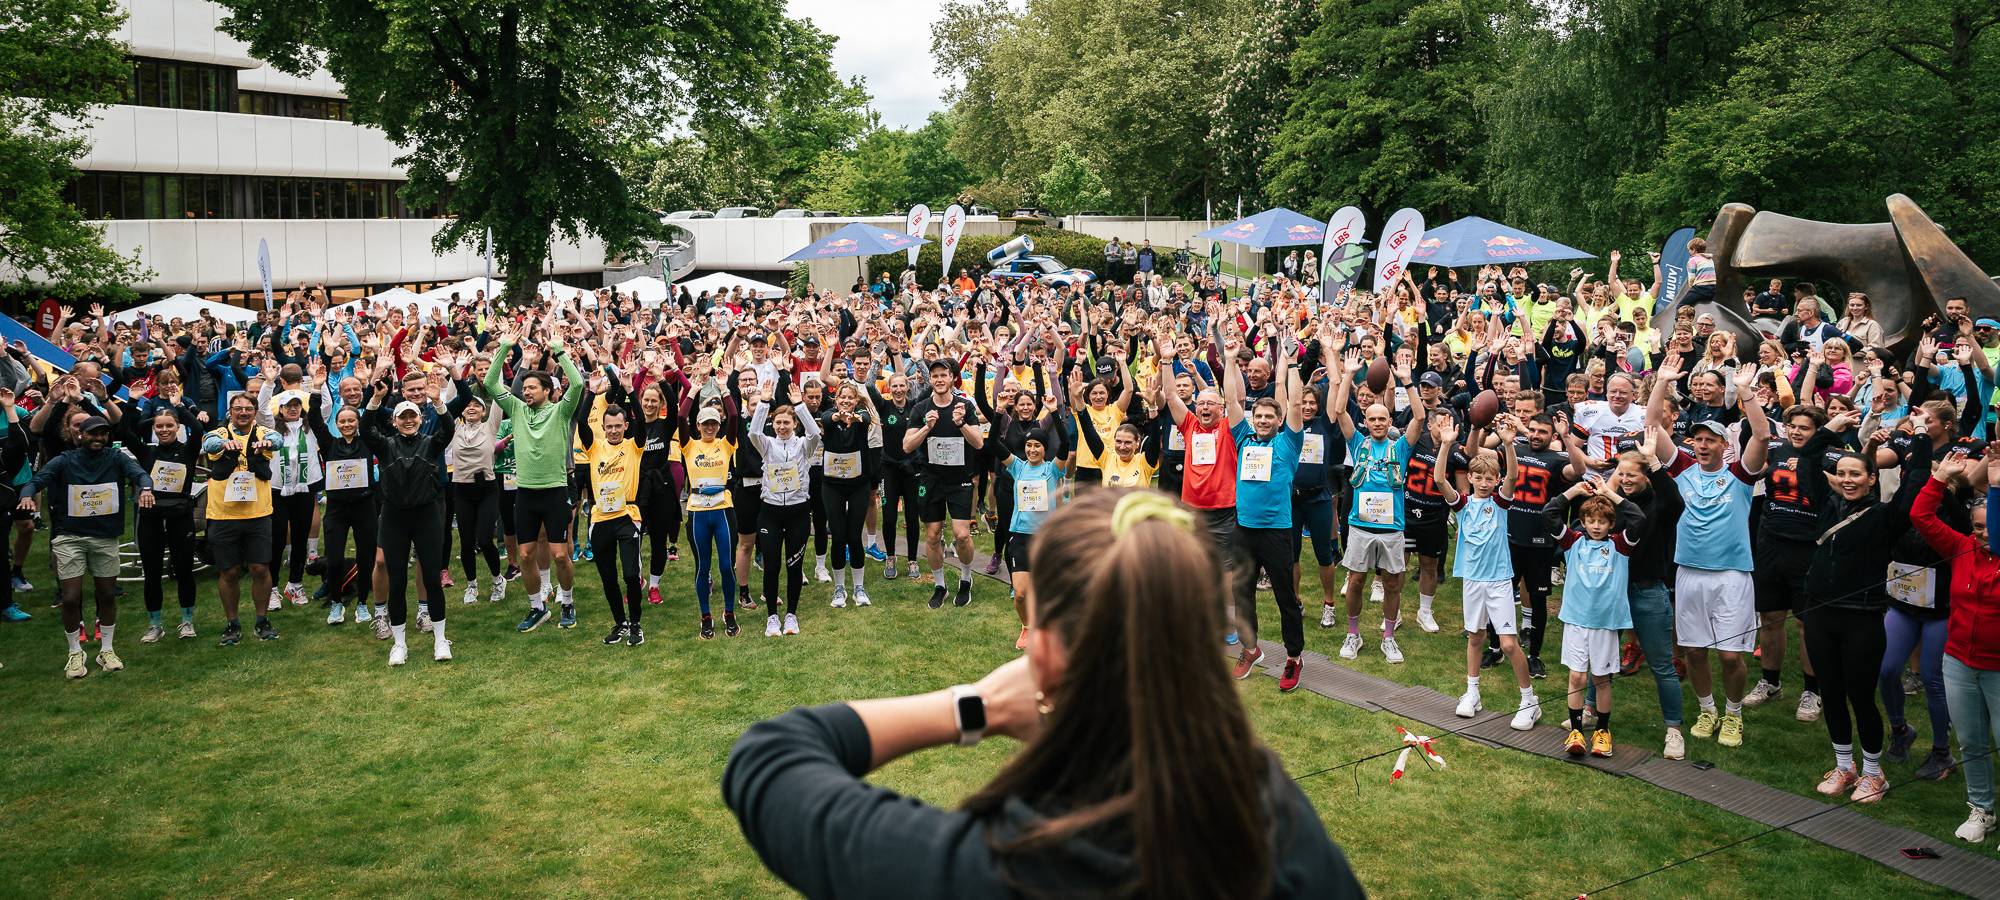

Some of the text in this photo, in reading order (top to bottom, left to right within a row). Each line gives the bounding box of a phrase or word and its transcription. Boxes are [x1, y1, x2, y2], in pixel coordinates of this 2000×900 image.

[913, 216, 922, 226] LBS
[948, 217, 957, 228] LBS
[946, 236, 955, 247] LBS
[1334, 231, 1350, 247] LBS
[1390, 233, 1407, 250] LBS
[1383, 263, 1401, 281] LBS
